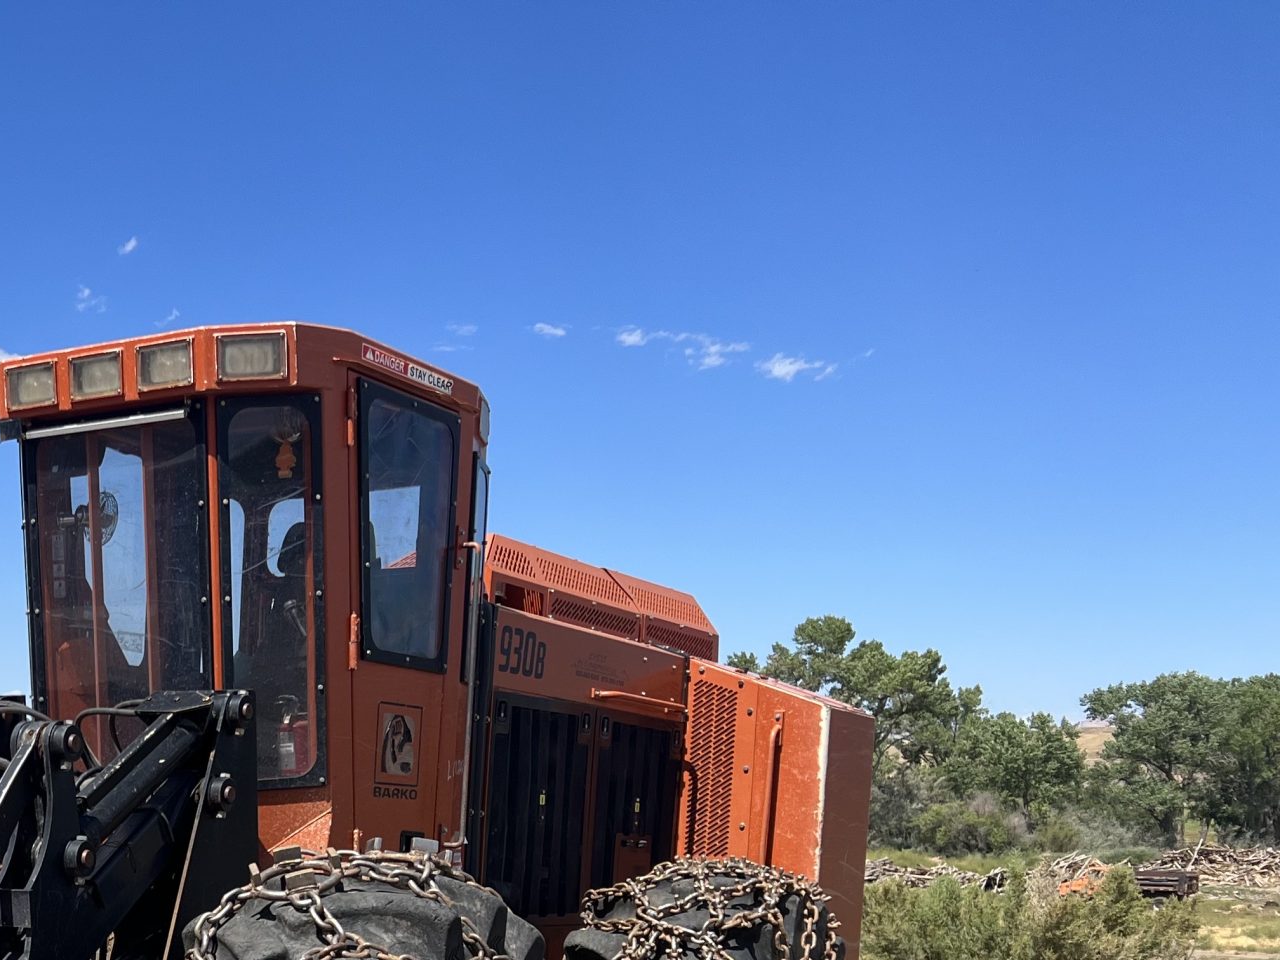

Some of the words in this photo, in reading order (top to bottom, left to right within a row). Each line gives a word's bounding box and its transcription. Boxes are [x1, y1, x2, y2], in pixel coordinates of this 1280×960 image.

[374, 351, 405, 373] DANGER
[409, 366, 427, 382] STAY
[428, 374, 453, 391] CLEAR
[498, 625, 546, 679] 930B
[373, 786, 418, 800] BARKO
